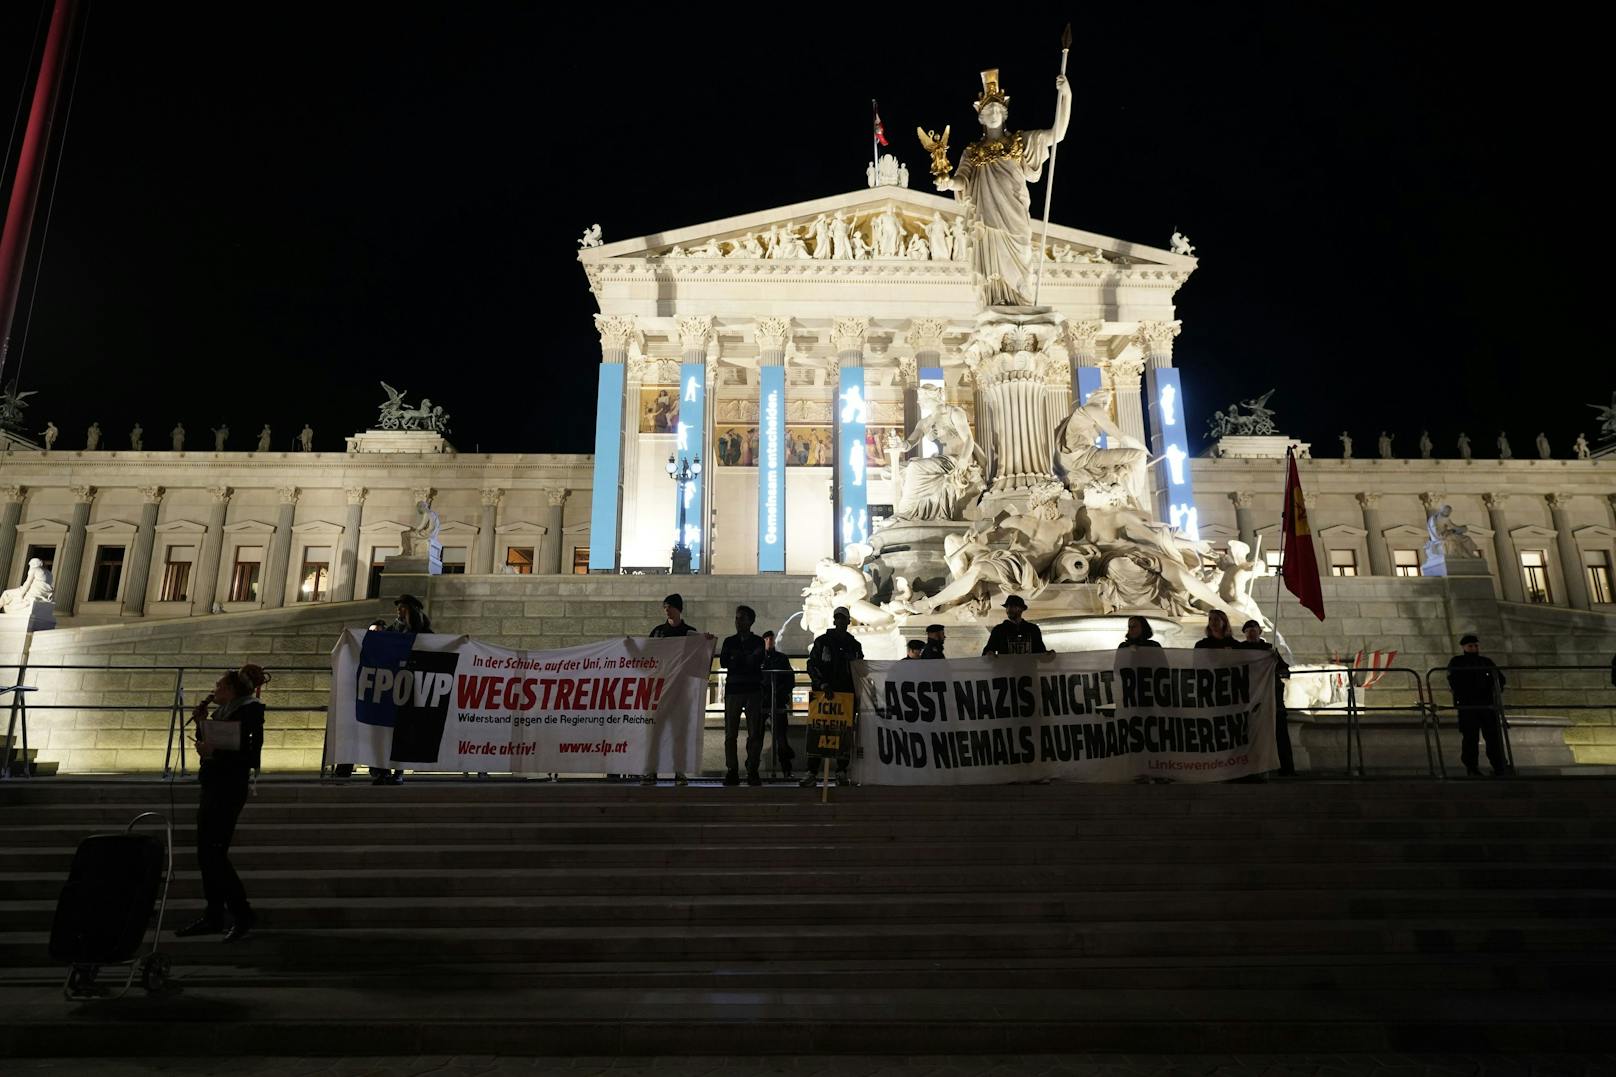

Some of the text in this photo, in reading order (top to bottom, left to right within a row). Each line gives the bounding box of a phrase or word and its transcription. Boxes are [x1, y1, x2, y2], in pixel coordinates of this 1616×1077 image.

[765, 390, 777, 544] Gemeinsam entscheiden.
[473, 655, 482, 667] In
[484, 656, 502, 669] der
[504, 657, 542, 671] Schule,
[583, 657, 602, 671] Uni,
[604, 657, 616, 669] im
[619, 655, 659, 669] Betrieb:
[458, 674, 664, 711] WEGSTREIKEN!
[953, 676, 1035, 720] NAZIS
[1040, 670, 1114, 716] NICHT
[1119, 665, 1250, 708] REGIEREN
[458, 714, 656, 726] Widerstand gegen die Regierung der Reichen.
[458, 741, 536, 755] Werde aktiv!
[559, 739, 628, 756] www.slp.at
[877, 712, 1249, 769] UND NIEMALS AUFMARSCHIEREN!
